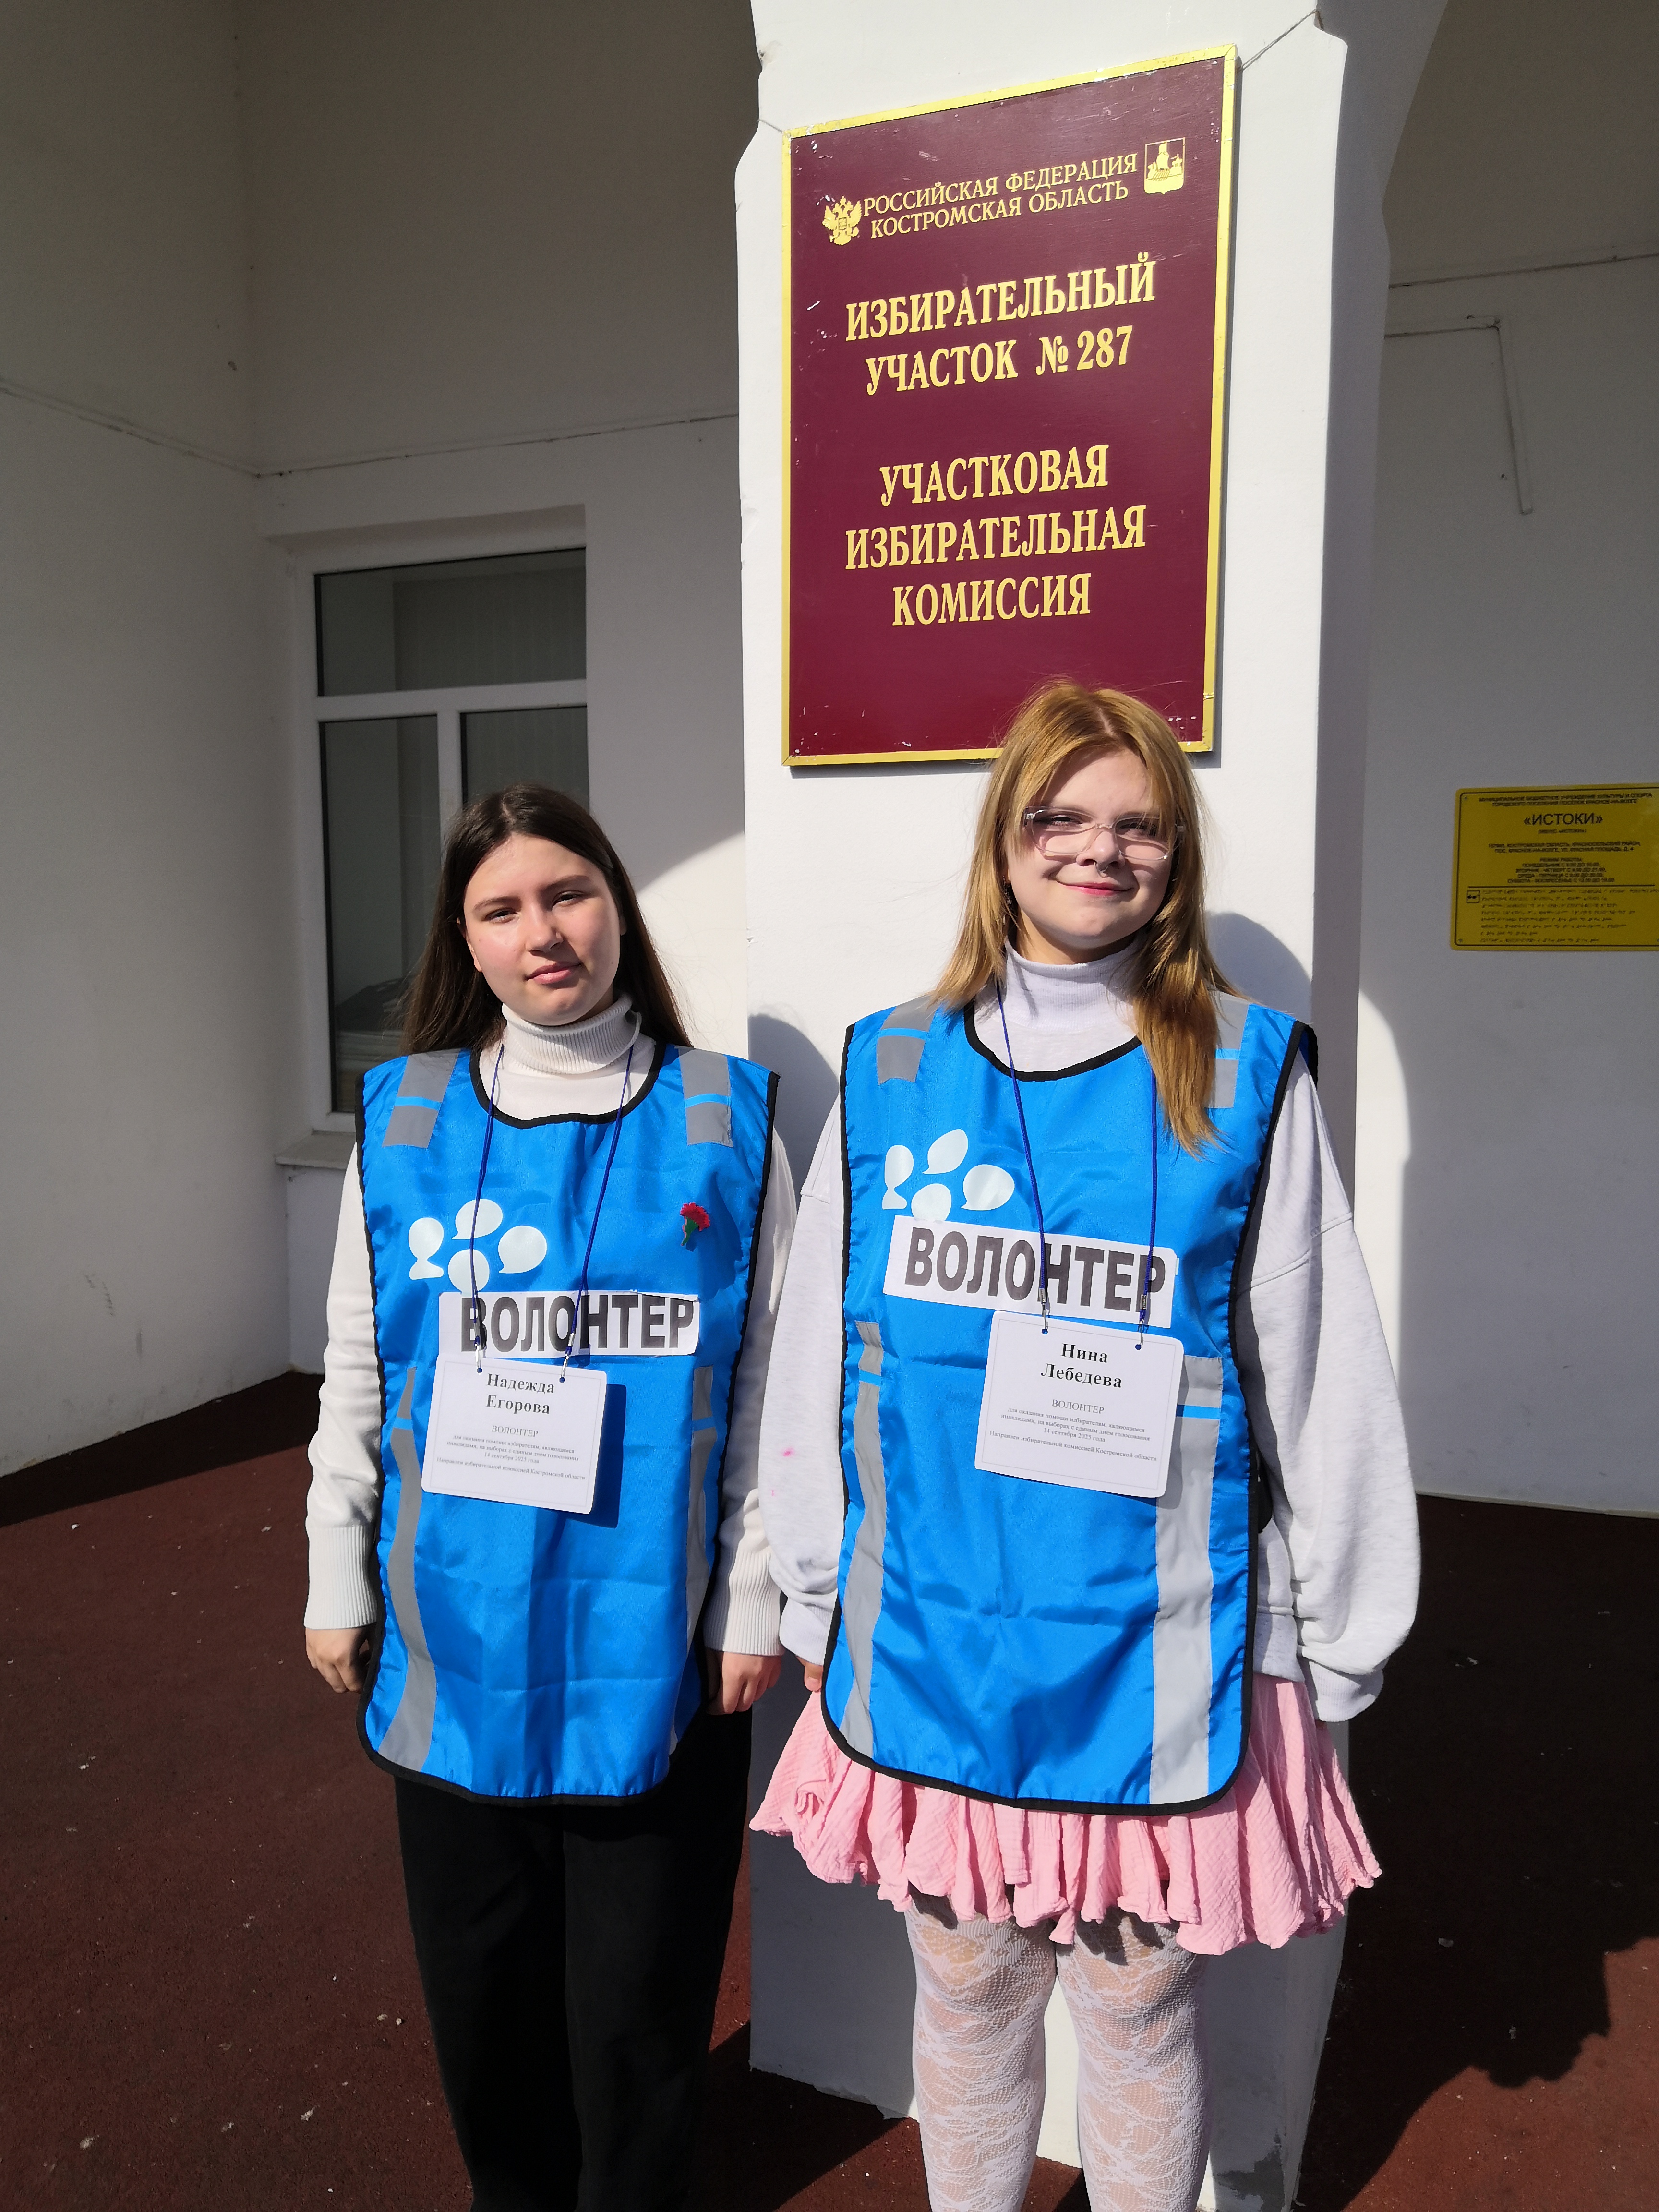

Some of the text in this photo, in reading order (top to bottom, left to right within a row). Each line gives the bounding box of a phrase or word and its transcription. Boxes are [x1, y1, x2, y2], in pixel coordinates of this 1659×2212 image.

[864, 153, 1137, 216] РОССИЙСКАЯ ФЕДЕРАЦИЯ
[871, 180, 1129, 239] КОСТРОМСКАЯ ОБЛАСТЬ
[846, 252, 1156, 341] ИЗБИРАТЕЛЬНЫЙ
[866, 325, 1133, 396] УЧАСТОК № 287
[879, 444, 1109, 507] УЧАСТКОВАЯ
[845, 505, 1146, 570] ИЗБИРАТЕЛЬНАЯ
[892, 573, 1092, 626] КОМИССИЯ
[1524, 812, 1603, 826] «ИСТОКИ»
[905, 1227, 1166, 1313] ВОЛОНТЕР
[461, 1294, 694, 1352] ВОЛОНТЕР
[1061, 1343, 1108, 1364] Нина
[485, 1373, 555, 1394] Надежда
[1041, 1363, 1122, 1389] Лебедева
[485, 1395, 550, 1415] Егорова
[1052, 1399, 1104, 1414] ВОЛОНТЕР
[492, 1425, 538, 1437] ВОЛОНТЕР
[1046, 1421, 1070, 1429] выборах
[1051, 1430, 1076, 1438] сентября
[990, 1431, 1020, 1440] Направлен
[1021, 1436, 1062, 1447] избирательной
[1064, 1443, 1094, 1452] комиссией
[1096, 1447, 1133, 1458] Костромской
